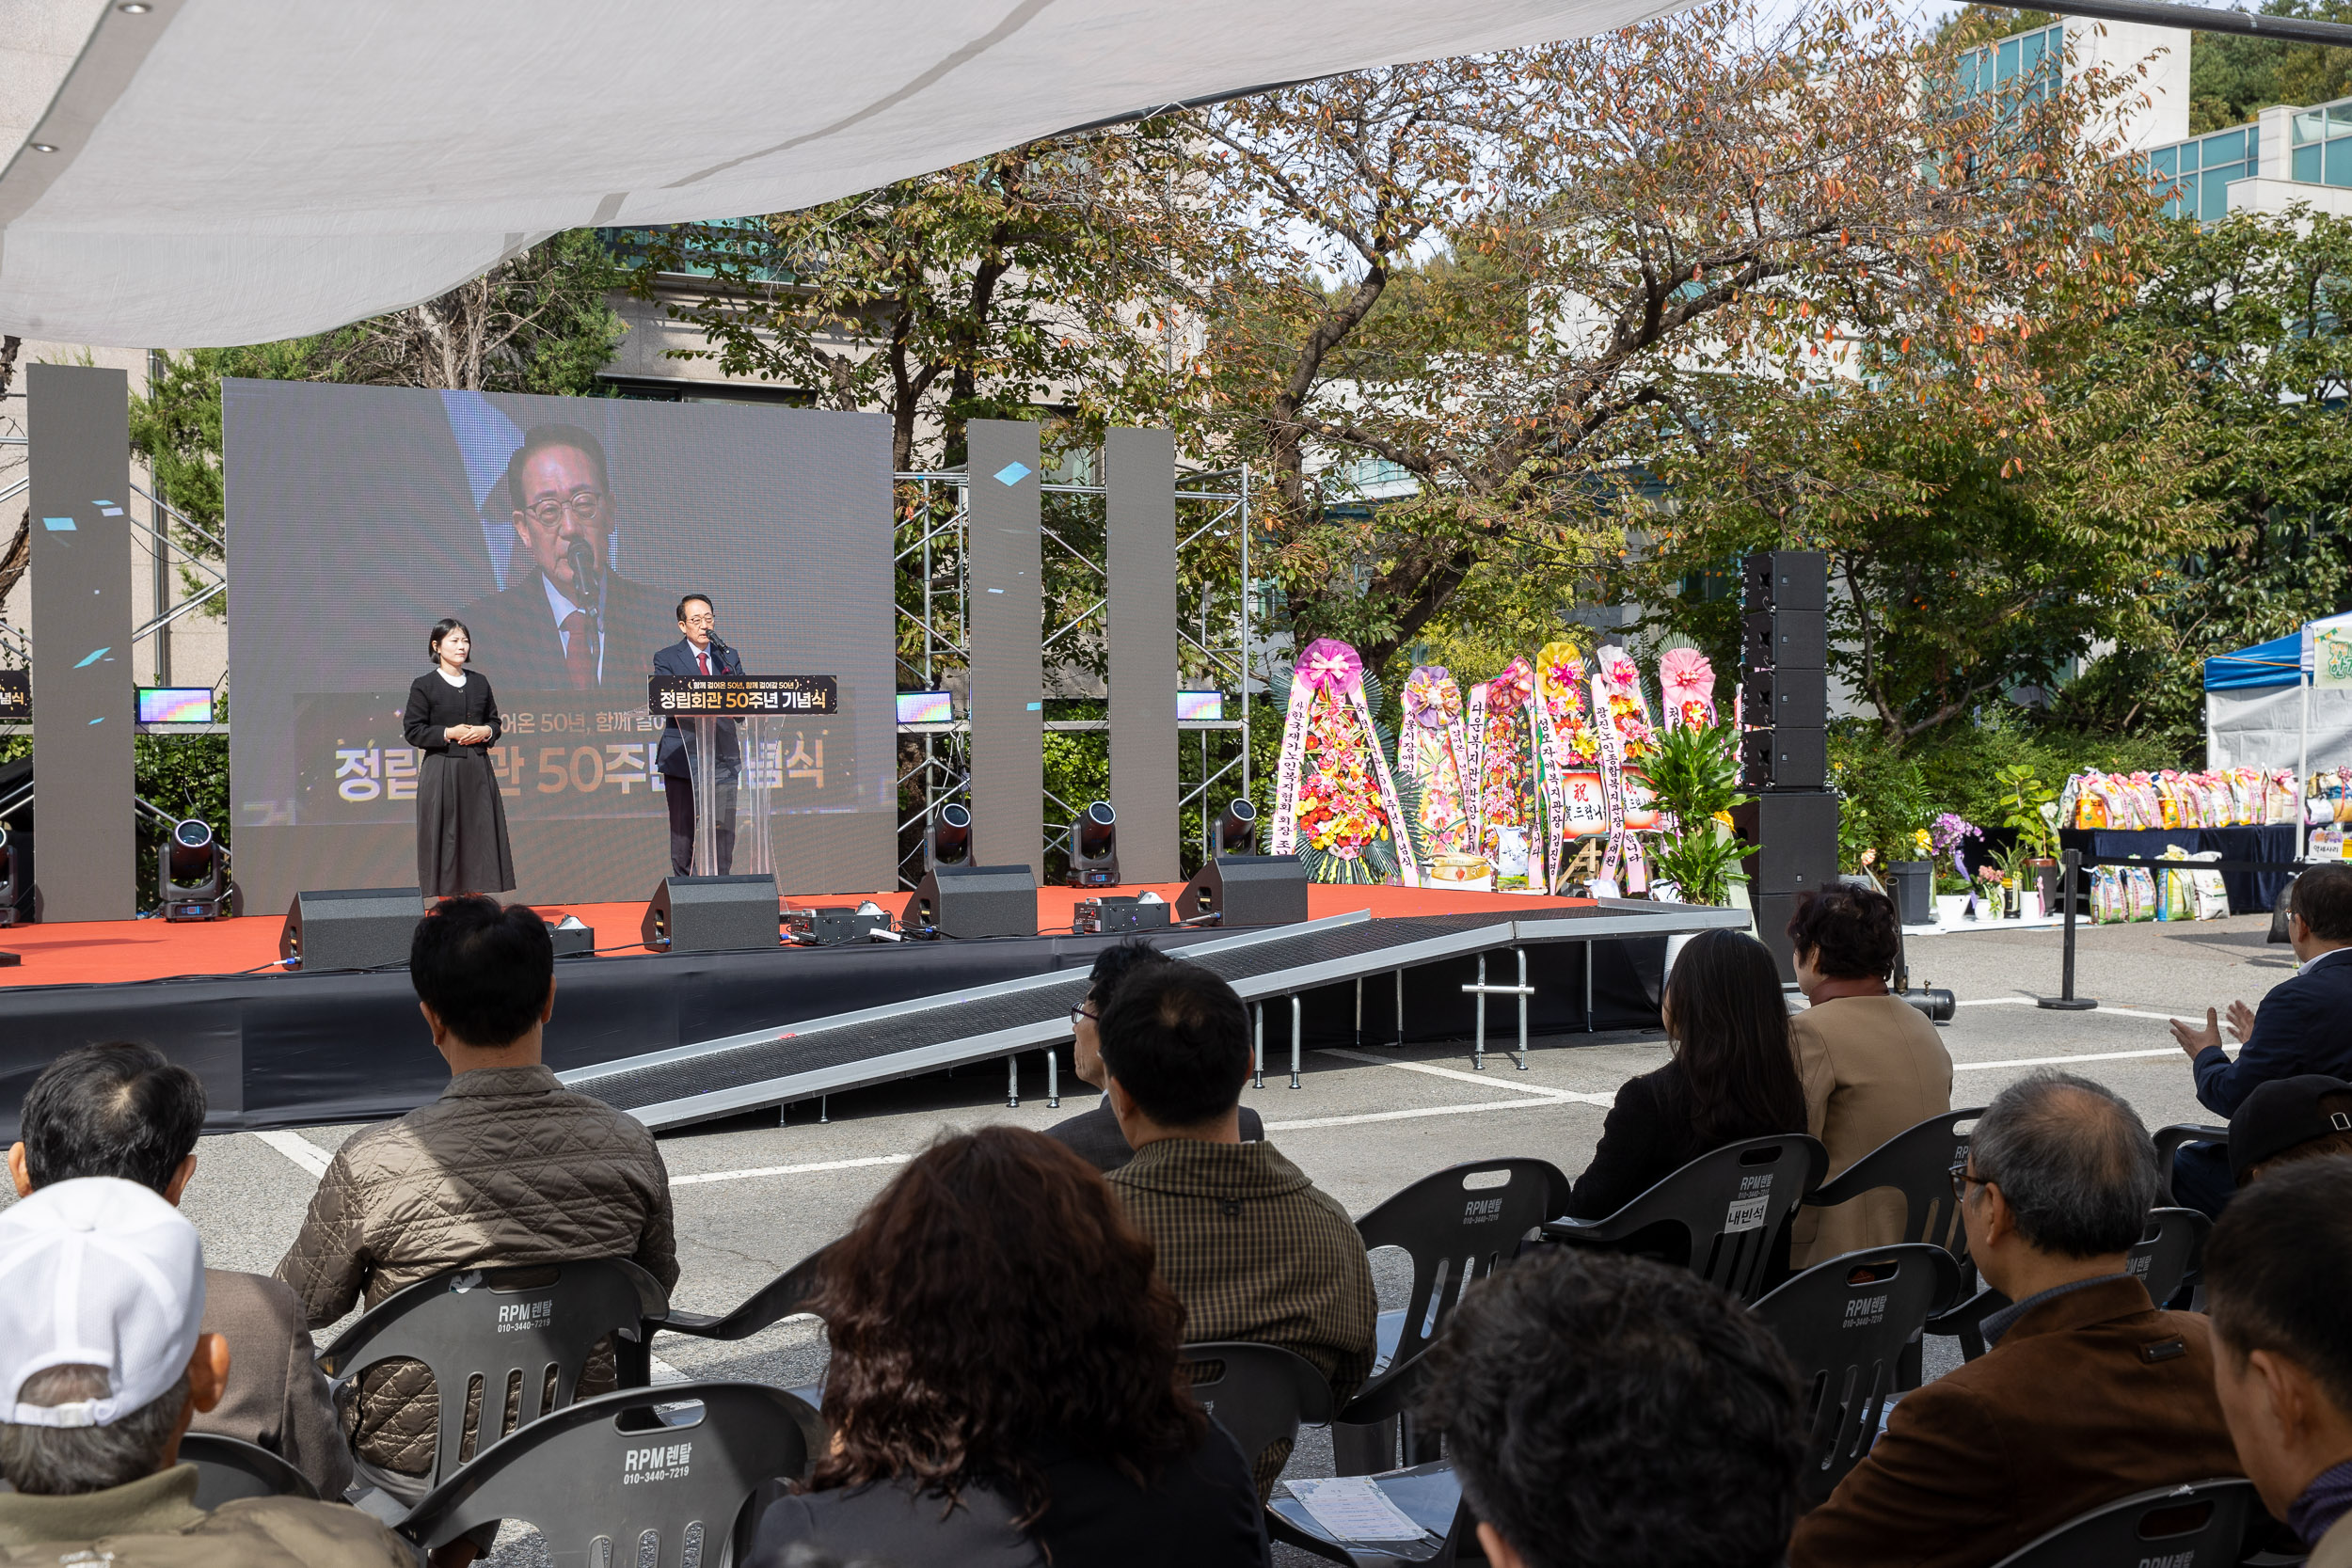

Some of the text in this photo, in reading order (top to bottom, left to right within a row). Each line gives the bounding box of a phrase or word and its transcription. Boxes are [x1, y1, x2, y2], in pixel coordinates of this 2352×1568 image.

[660, 691, 826, 709] 정립회관 50주년 기념식
[501, 713, 534, 735] 어온
[596, 711, 631, 733] 함께
[1596, 706, 1624, 829] 광진노인종합복지관장
[1574, 783, 1589, 802] 祝
[1278, 816, 1293, 836] 회장
[1395, 830, 1413, 869] 기념식
[1728, 1205, 1765, 1226] 내빈석
[498, 1299, 553, 1323] RPM렌탈
[497, 1318, 551, 1333] 010-3440-7219
[625, 1442, 692, 1472] RPM렌탈
[623, 1465, 690, 1485] 010-3440-7219
